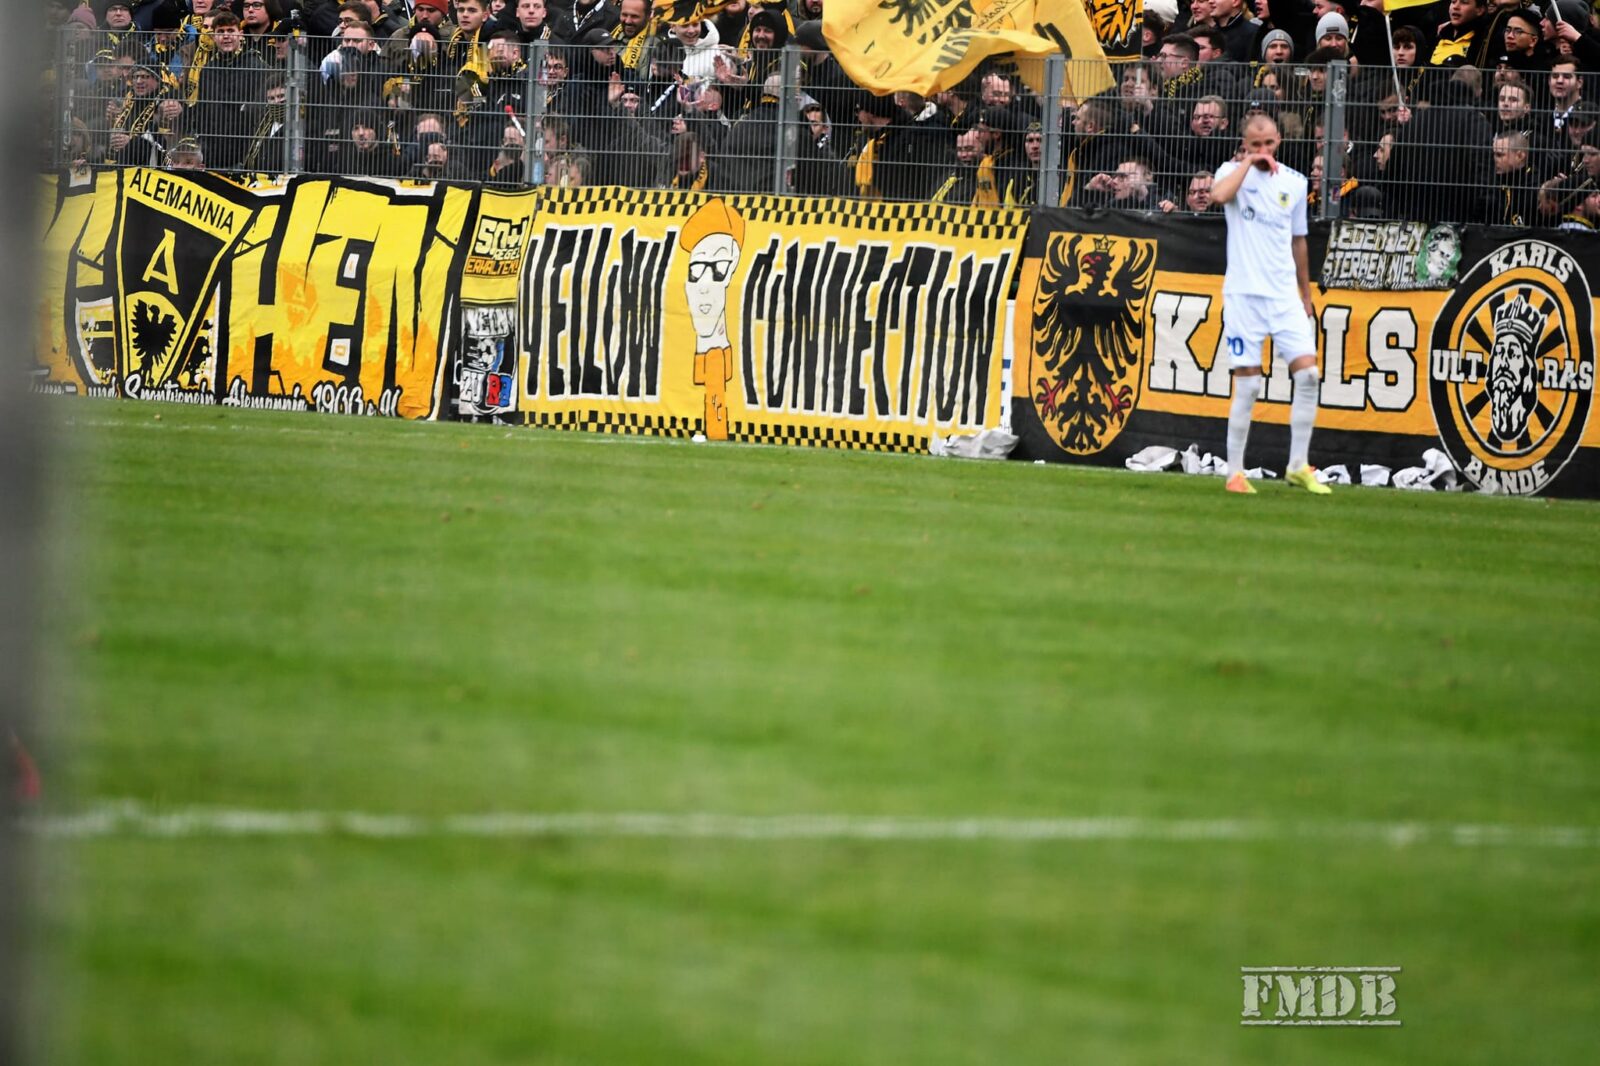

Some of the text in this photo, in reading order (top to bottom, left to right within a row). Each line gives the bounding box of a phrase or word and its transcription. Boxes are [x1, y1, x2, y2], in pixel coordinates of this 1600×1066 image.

[129, 168, 235, 235] ALEMANNIA
[142, 228, 179, 295] A
[1489, 241, 1574, 284] KARLS
[519, 224, 677, 402] YELLOW
[742, 234, 1014, 429] CONNECTION
[1149, 290, 1418, 412] KLS
[1464, 456, 1550, 495] BANDE
